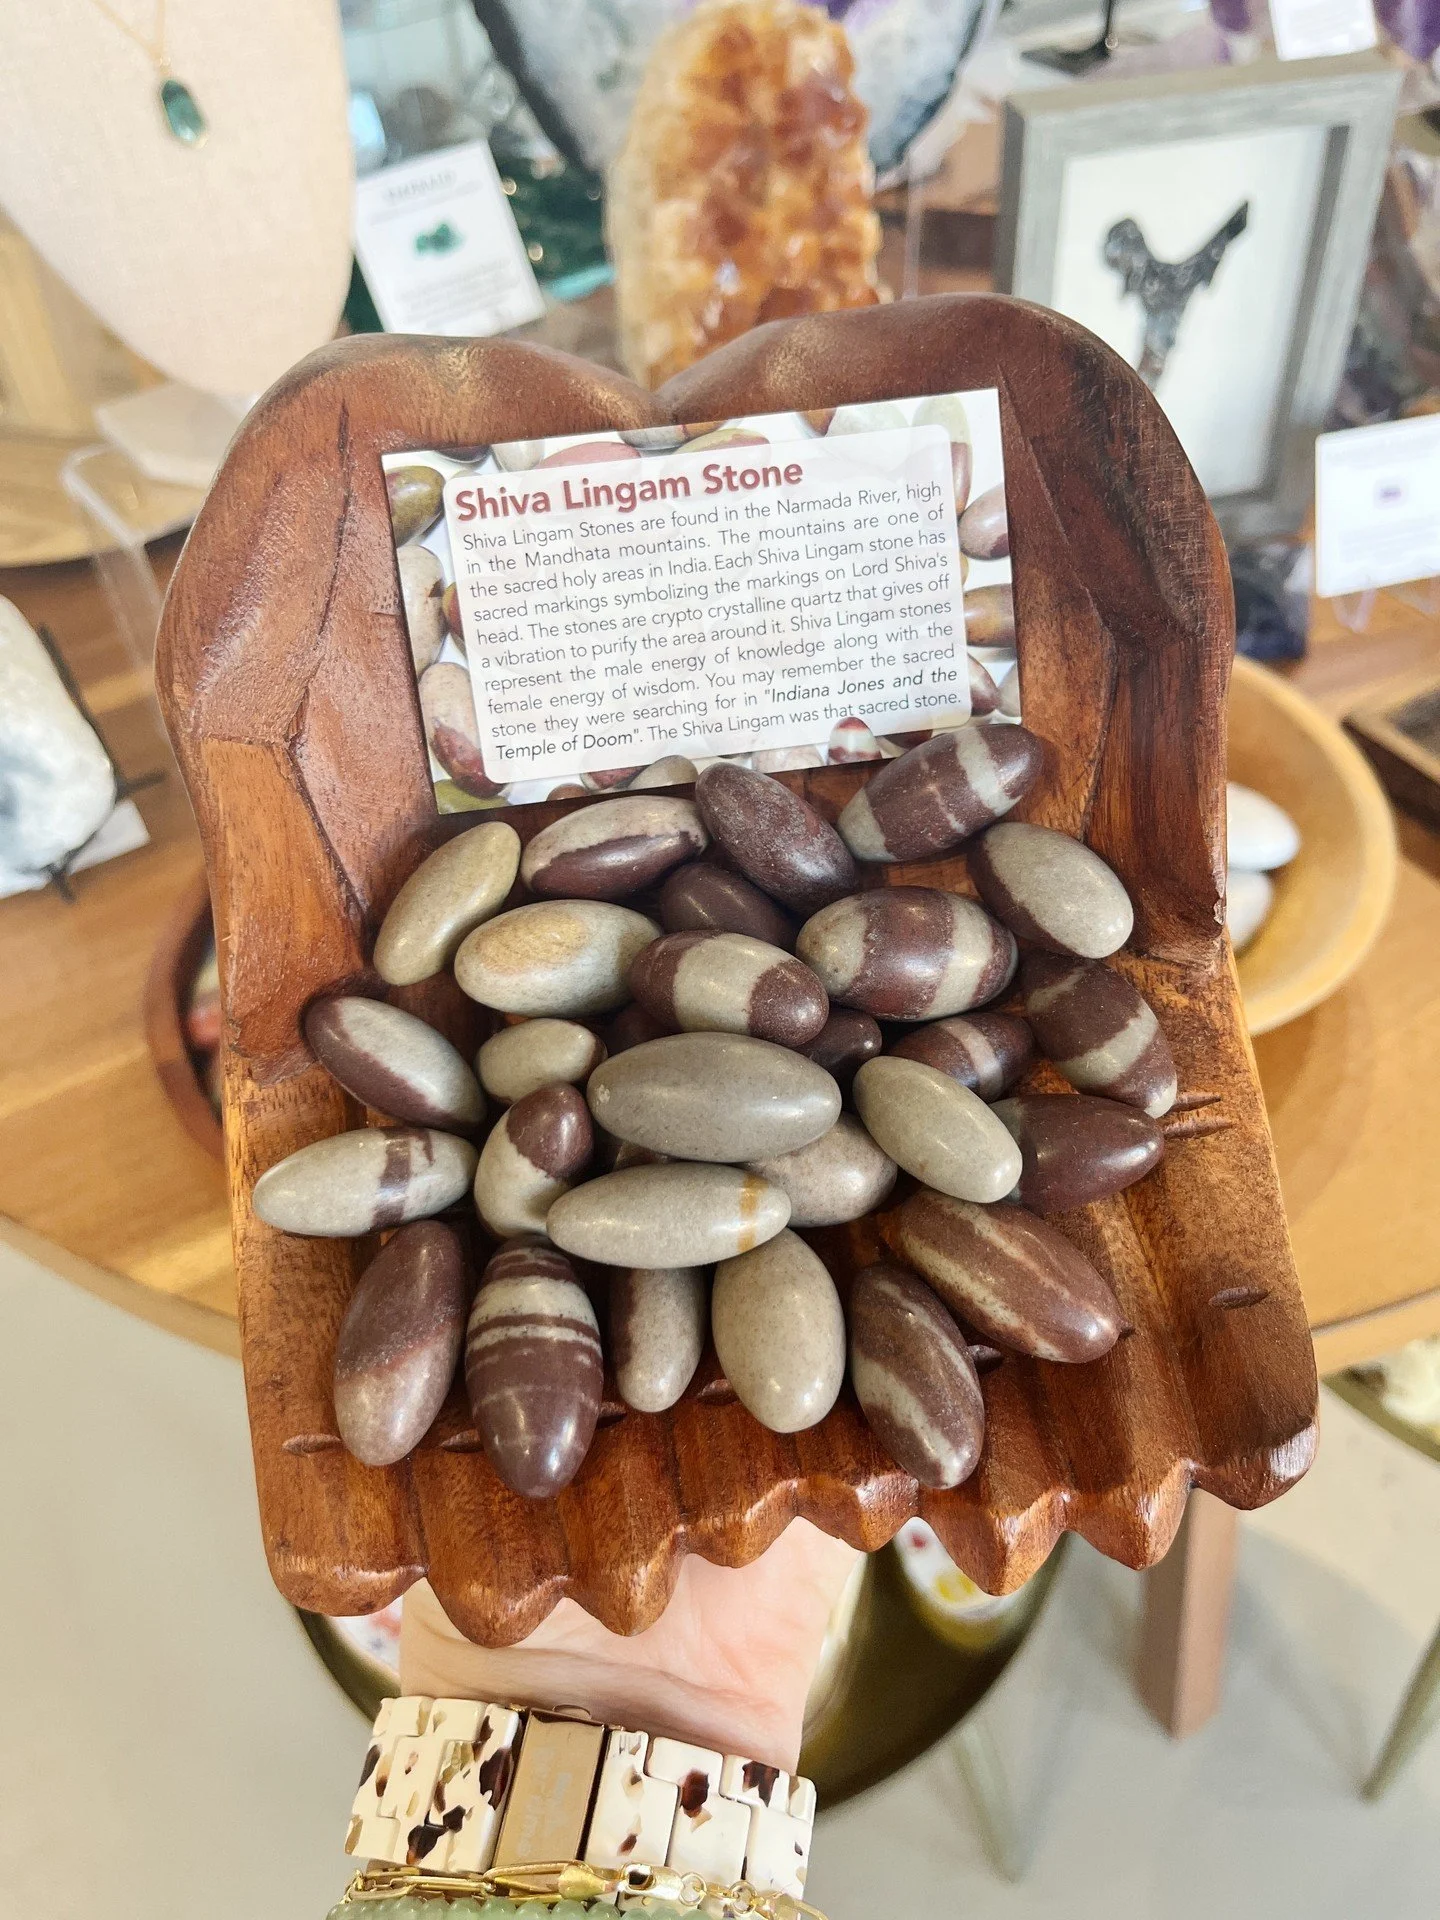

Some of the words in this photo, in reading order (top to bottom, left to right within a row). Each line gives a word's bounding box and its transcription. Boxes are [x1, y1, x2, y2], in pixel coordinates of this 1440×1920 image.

[455, 487, 552, 522] Shiva
[562, 475, 692, 514] Lingam
[702, 463, 804, 496] Stone
[462, 532, 507, 551] Shiva
[512, 528, 574, 547] Lingam
[578, 521, 635, 538] Stones
[640, 517, 666, 532] are
[670, 506, 719, 528] found
[724, 506, 739, 522] in
[744, 502, 771, 519] the
[776, 491, 852, 516] Narmada
[858, 489, 901, 506] River,
[906, 480, 942, 503] high
[466, 559, 482, 575] in
[487, 554, 517, 572] the
[524, 545, 611, 568] Mandhata
[618, 535, 711, 558] mountains.
[717, 528, 751, 546] The
[758, 518, 846, 542] mountains
[853, 516, 880, 530] are
[887, 511, 920, 526] one
[927, 502, 944, 521] of
[469, 580, 498, 598] the
[503, 572, 559, 595] sacred
[562, 568, 597, 590] holy
[602, 568, 645, 584] areas
[648, 562, 664, 578] in
[668, 556, 712, 576] India.
[714, 550, 753, 571] Each
[757, 547, 800, 566] Shiva
[804, 542, 864, 562] Lingam
[869, 536, 914, 552] stone
[918, 529, 946, 546] has
[473, 599, 529, 623] sacred
[534, 595, 609, 615] markings
[613, 582, 709, 610] symbolizing
[714, 576, 741, 594] the
[746, 570, 820, 590] markings
[825, 568, 846, 581] on
[852, 557, 889, 578] Lord
[894, 551, 948, 573] Shiva's
[476, 624, 524, 646] head.
[526, 621, 560, 639] The
[564, 618, 618, 636] stones
[622, 615, 647, 629] are
[651, 607, 703, 628] crypto
[707, 595, 786, 622] crystalline
[790, 590, 843, 613] quartz
[845, 584, 878, 602] that
[881, 581, 924, 602] gives
[927, 572, 950, 592] off
[481, 657, 491, 669] a
[494, 646, 566, 667] vibration
[569, 645, 588, 659] to
[591, 635, 638, 661] purify
[641, 632, 668, 650] the
[672, 631, 707, 647] area
[710, 619, 767, 642] around
[771, 619, 786, 634] it.
[790, 614, 832, 632] Shiva
[836, 608, 895, 628] Lingam
[899, 601, 952, 619] stones
[484, 669, 564, 696] represent
[569, 665, 597, 682] the
[604, 658, 643, 678] male
[651, 655, 706, 673] energy
[714, 646, 730, 665] of
[737, 637, 826, 661] knowledge
[833, 632, 879, 650] along
[885, 624, 919, 643] with
[926, 621, 953, 638] the
[487, 693, 543, 715] female
[549, 690, 605, 708] energy
[611, 682, 628, 700] of
[632, 677, 700, 697] wisdom.
[704, 672, 736, 688] You
[742, 669, 775, 686] may
[781, 656, 865, 679] remember
[870, 651, 896, 668] the
[902, 642, 955, 665] sacred
[491, 722, 537, 738] stone
[543, 714, 579, 733] they
[585, 711, 626, 726] were
[632, 699, 708, 721] searching
[714, 693, 737, 710] for
[743, 691, 758, 707] in
[764, 684, 830, 703] "Indiana
[837, 679, 885, 695] Jones
[892, 668, 924, 689] and
[930, 666, 958, 684] the
[495, 738, 557, 762] Temple
[561, 734, 579, 752] of
[583, 729, 643, 750] Doom".
[647, 724, 678, 741] The
[682, 720, 723, 737] Shiva
[727, 714, 785, 733] Lingam
[789, 710, 819, 724] was
[823, 702, 853, 719] that
[858, 693, 910, 715] sacred
[914, 693, 961, 709] stone.
